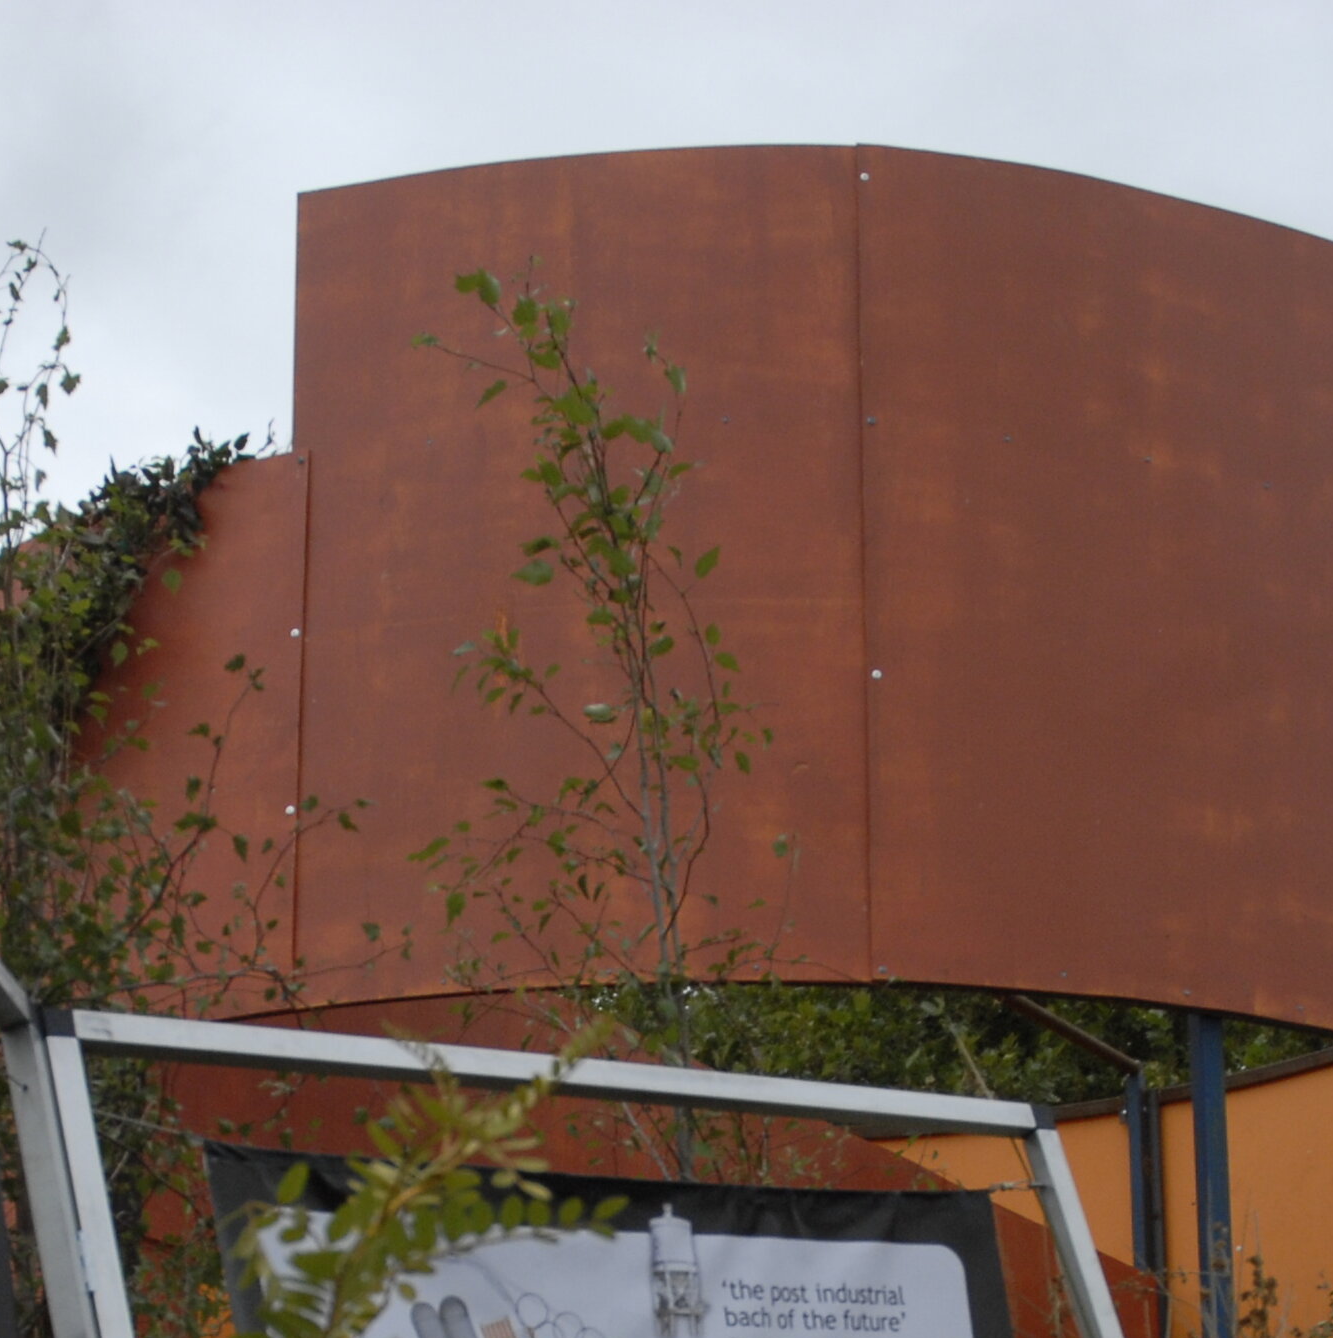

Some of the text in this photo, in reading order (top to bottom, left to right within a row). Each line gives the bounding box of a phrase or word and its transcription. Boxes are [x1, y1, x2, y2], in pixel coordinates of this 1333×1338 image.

[771, 1285, 809, 1306] post
[817, 1283, 906, 1305] industrial
[724, 1306, 771, 1327] bach
[777, 1309, 794, 1330] of
[803, 1310, 837, 1330] the
